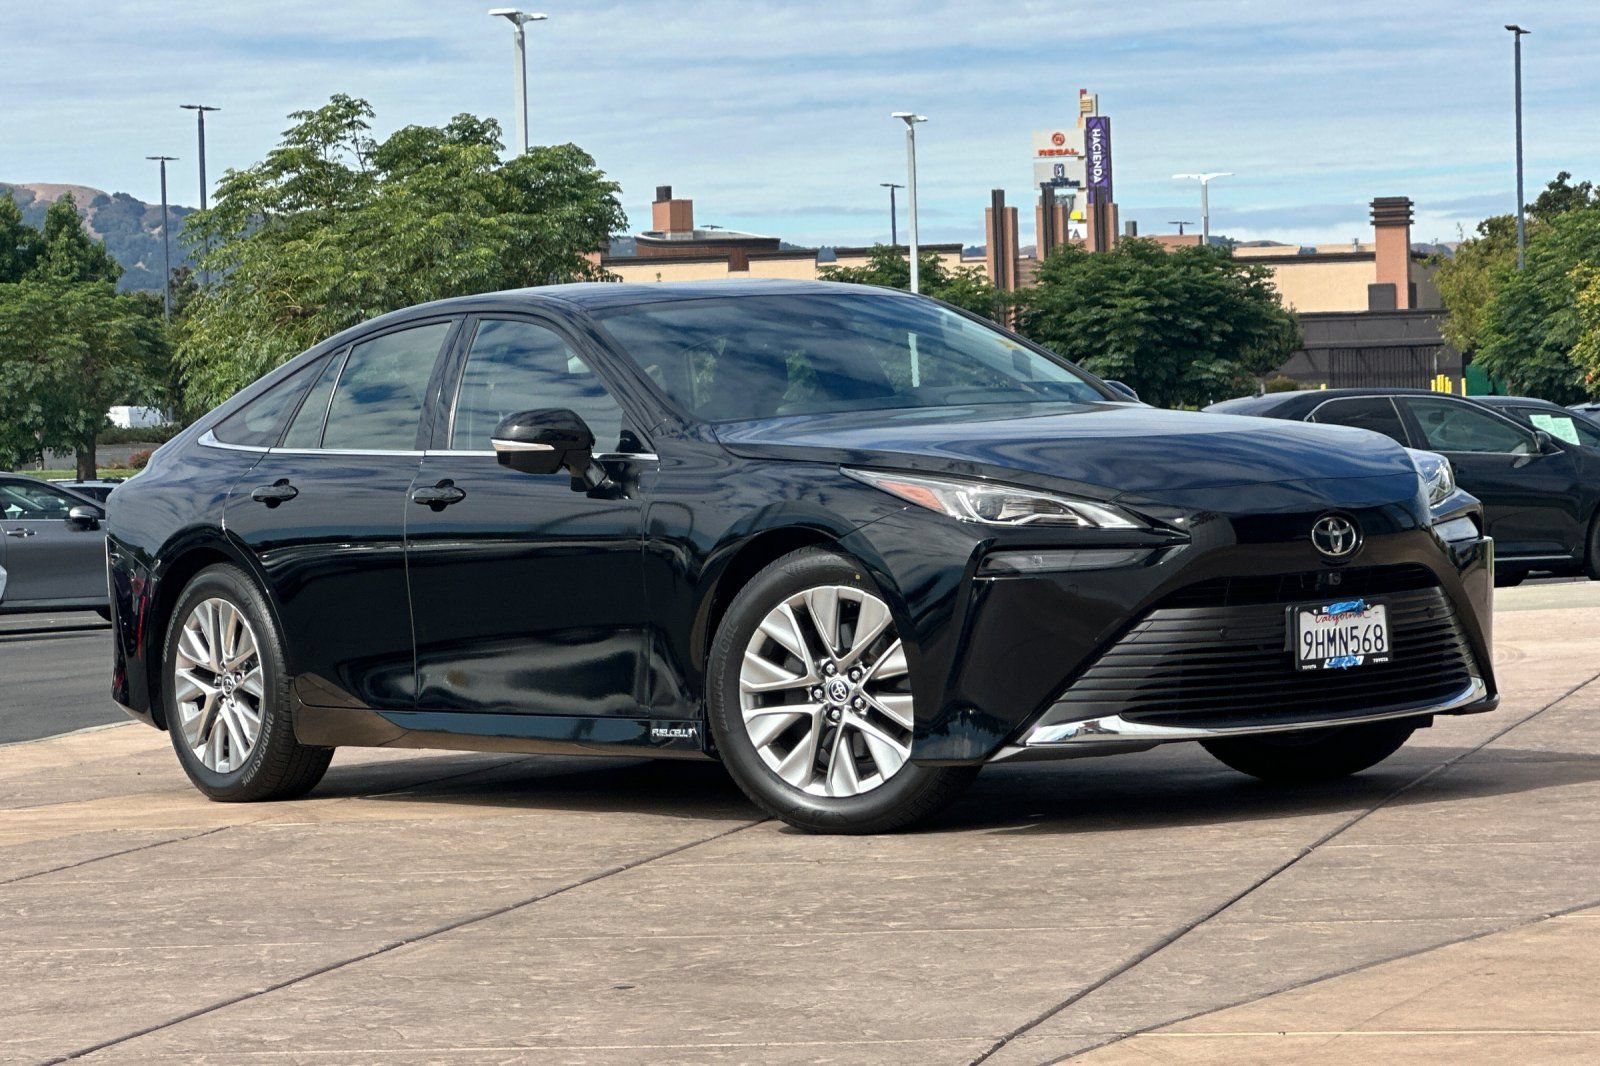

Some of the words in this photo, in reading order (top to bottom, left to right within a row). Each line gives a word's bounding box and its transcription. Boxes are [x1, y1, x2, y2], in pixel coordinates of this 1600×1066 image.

[1038, 147, 1079, 157] REGAL
[1091, 128, 1103, 184] HACIENDA
[1303, 623, 1385, 660] 9HMN568
